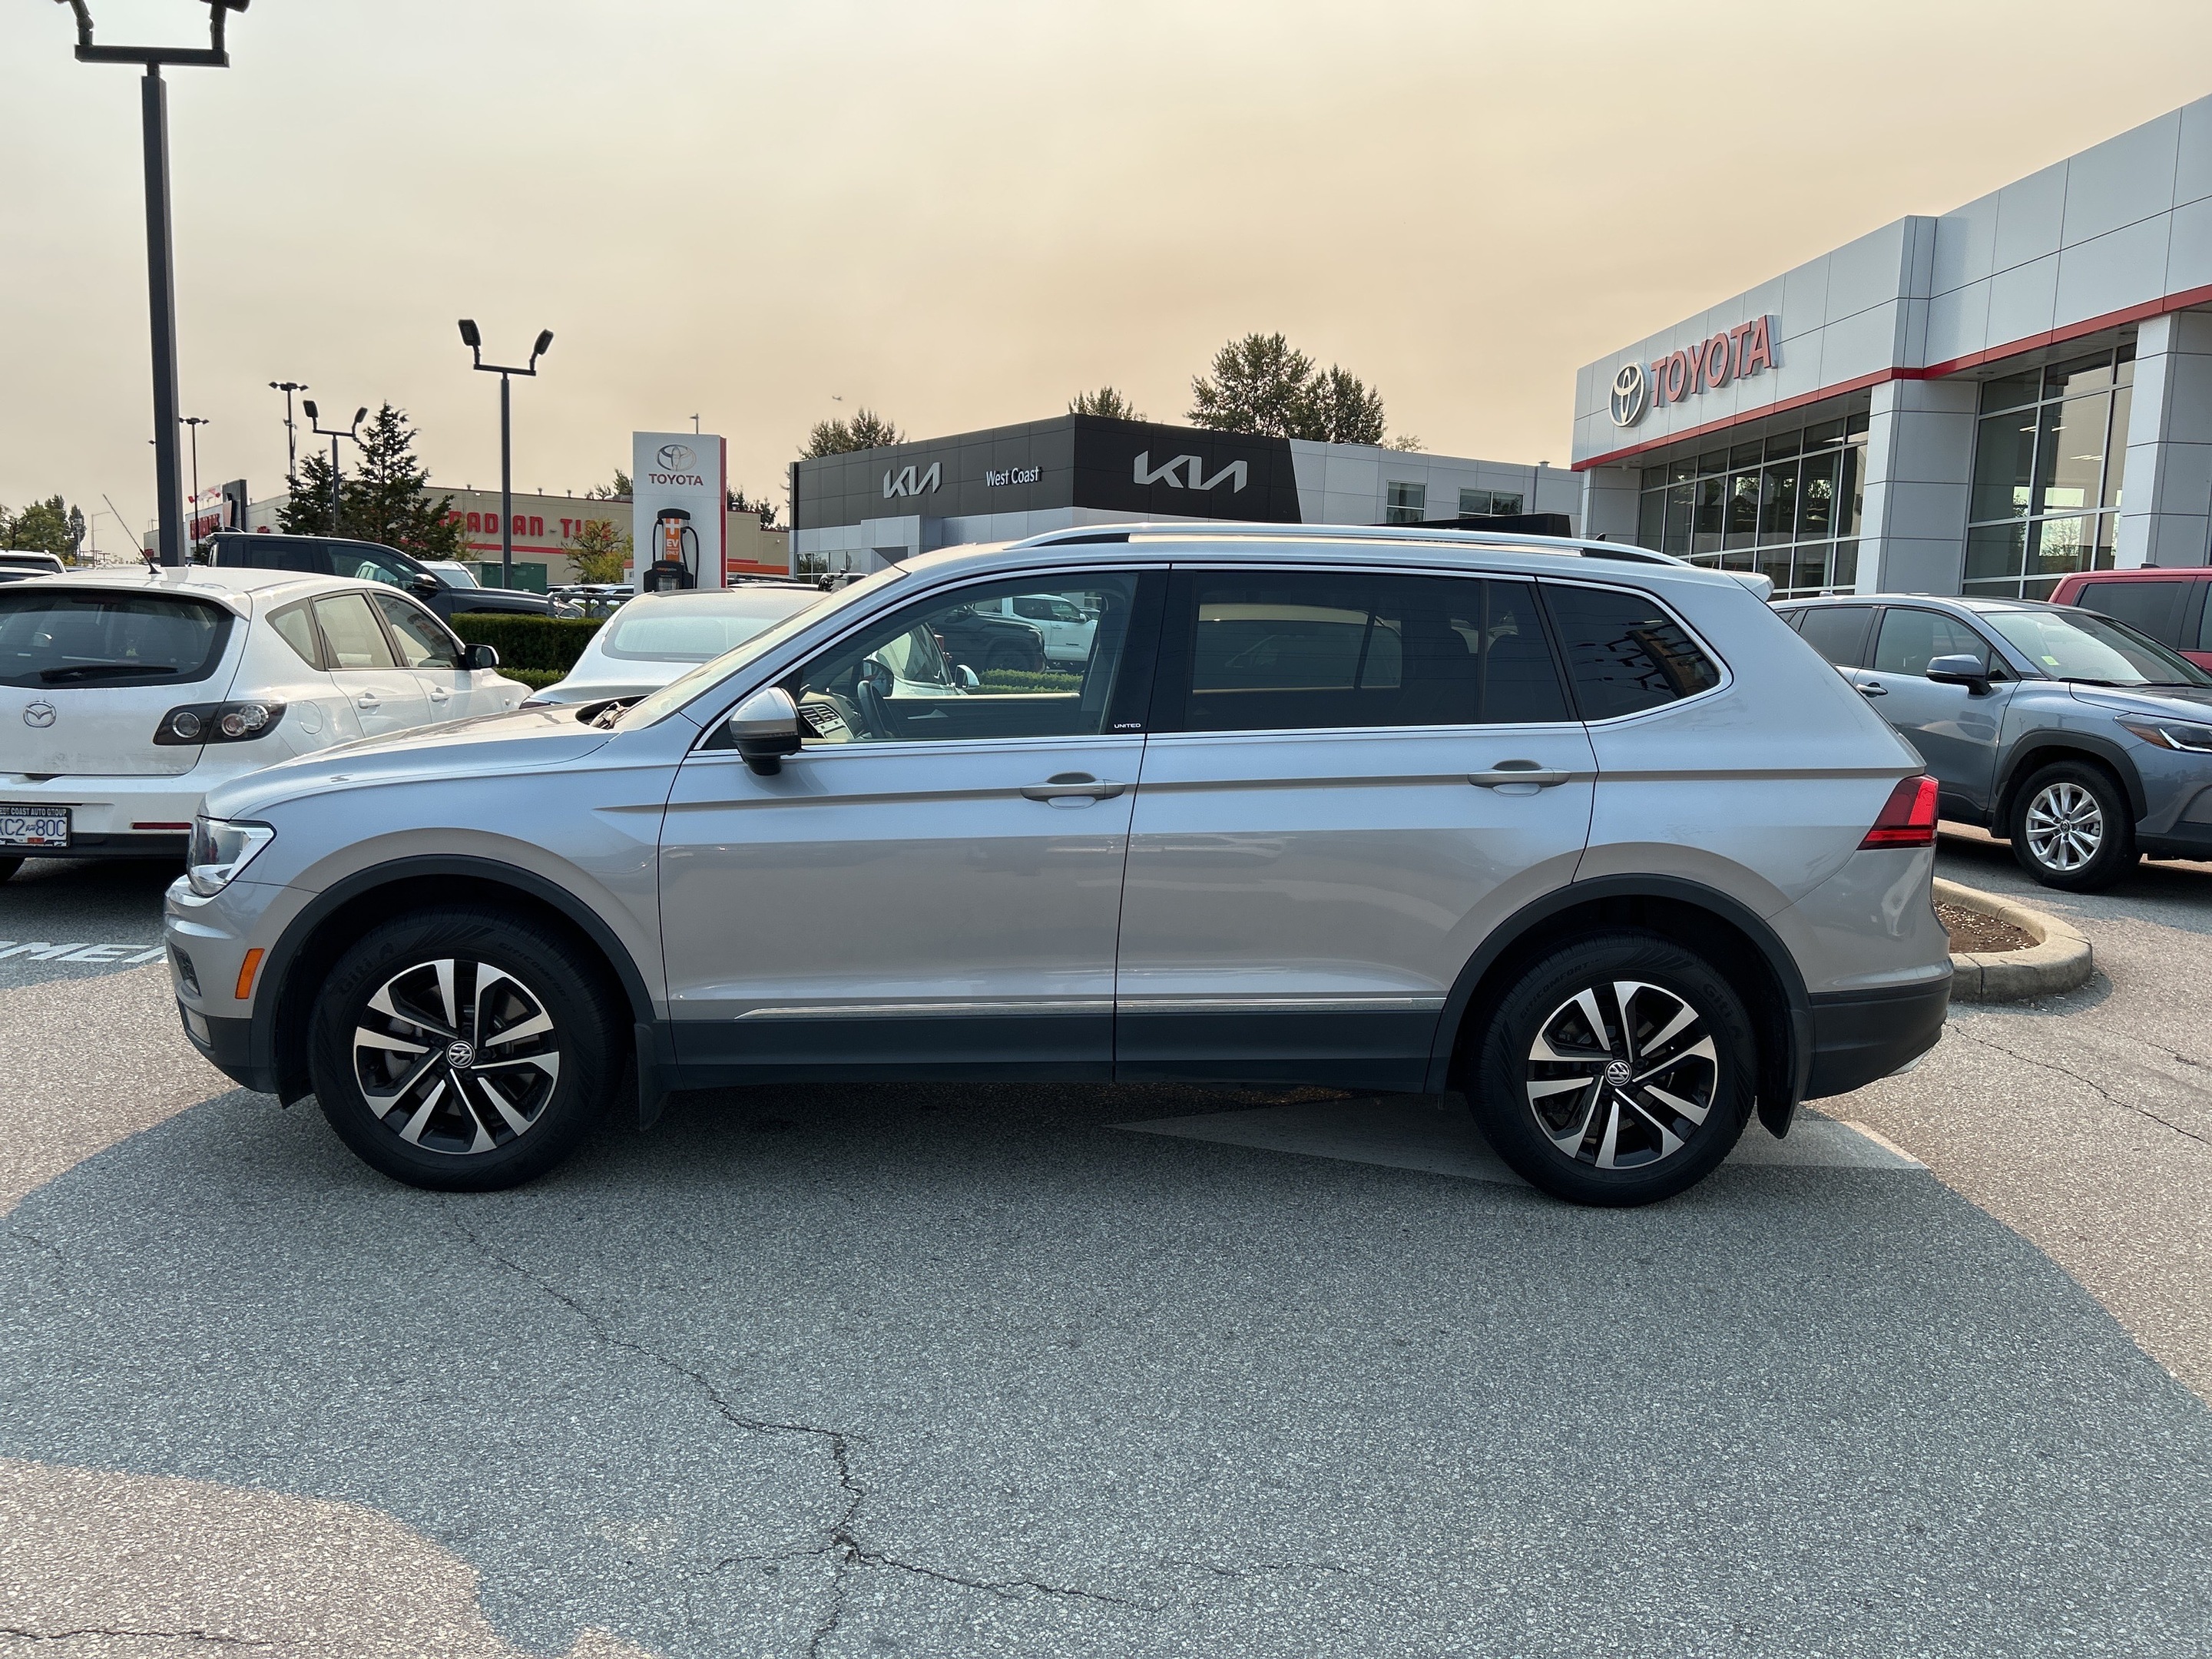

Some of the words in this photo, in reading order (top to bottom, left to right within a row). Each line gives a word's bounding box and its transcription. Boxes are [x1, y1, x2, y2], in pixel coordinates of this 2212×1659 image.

[1651, 314, 1773, 408] TOYOTA
[648, 473, 704, 486] TOYOTA
[882, 462, 942, 499] KIA
[985, 469, 1009, 487] West
[1011, 465, 1041, 485] Coast
[1133, 449, 1248, 494] KIA
[666, 538, 679, 548] EV
[11, 807, 30, 816] COAST
[31, 808, 46, 816] AUTO
